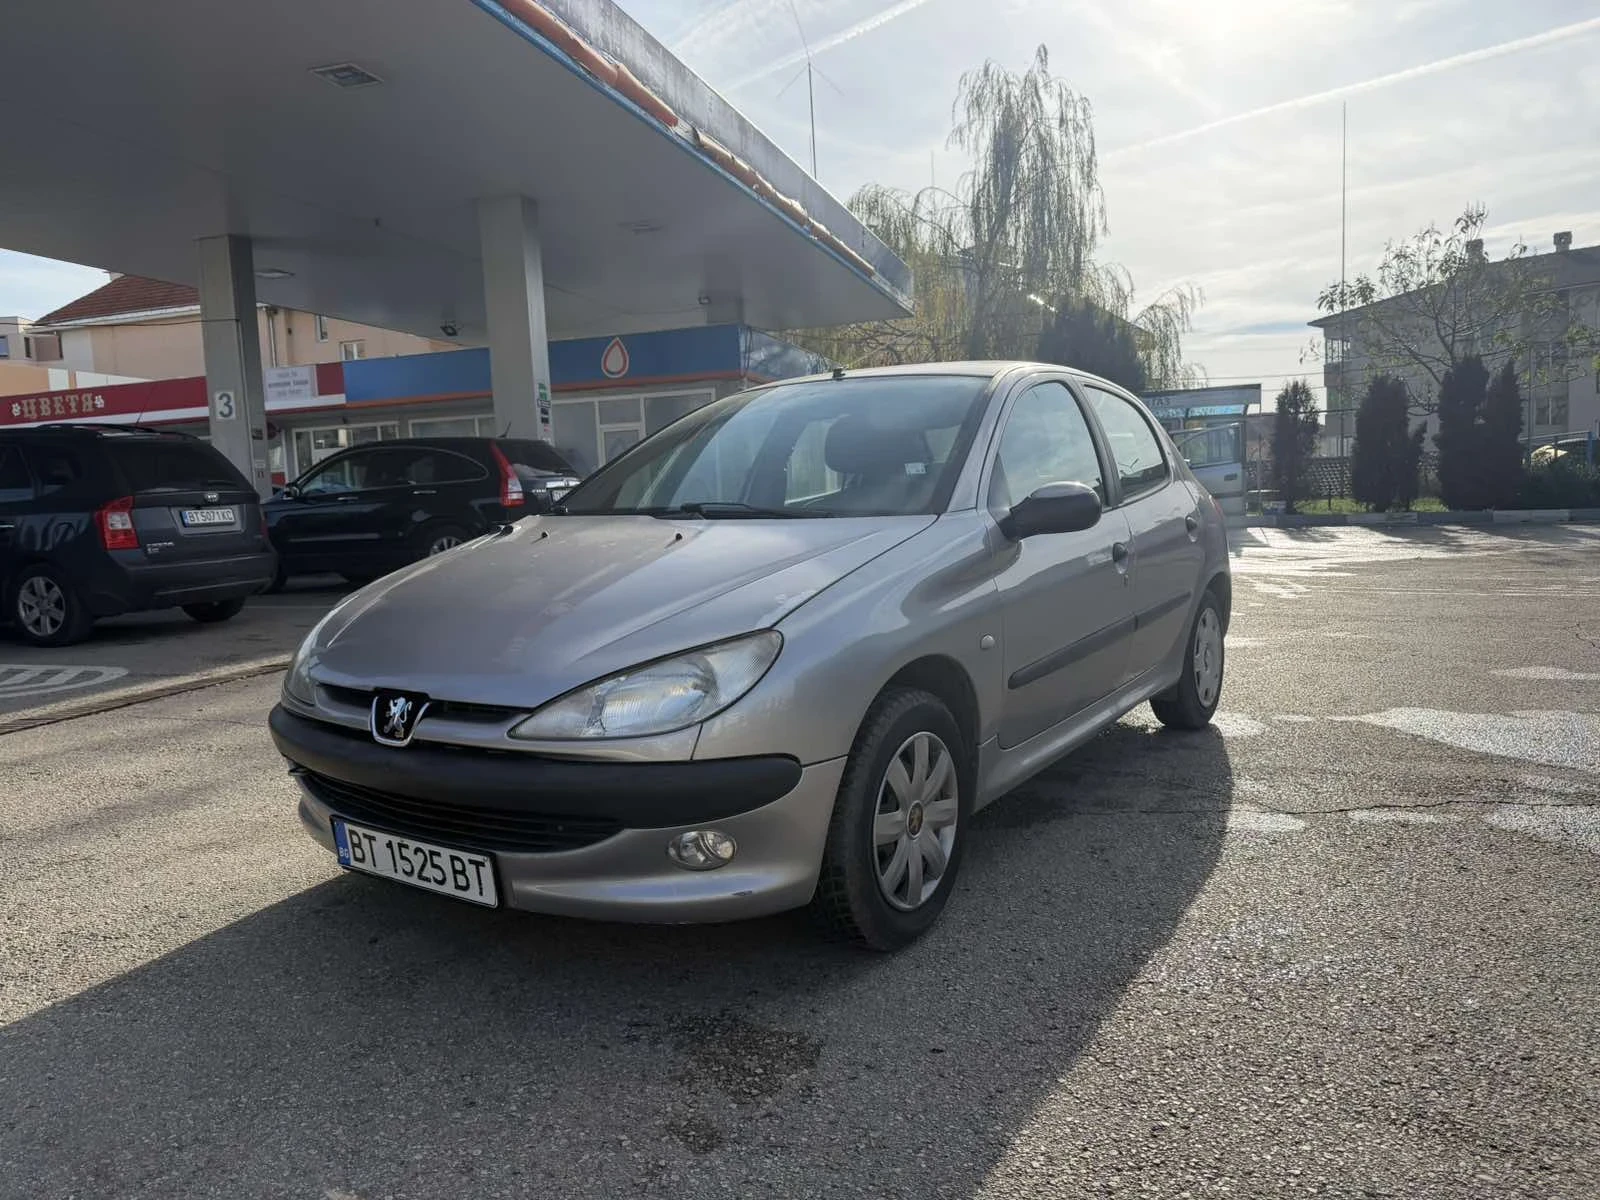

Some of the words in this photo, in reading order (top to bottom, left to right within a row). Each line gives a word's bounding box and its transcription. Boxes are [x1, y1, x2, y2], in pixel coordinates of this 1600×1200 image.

[22, 393, 95, 419] ЦВЕТЯ
[218, 392, 234, 418] 3
[338, 847, 350, 859] BG
